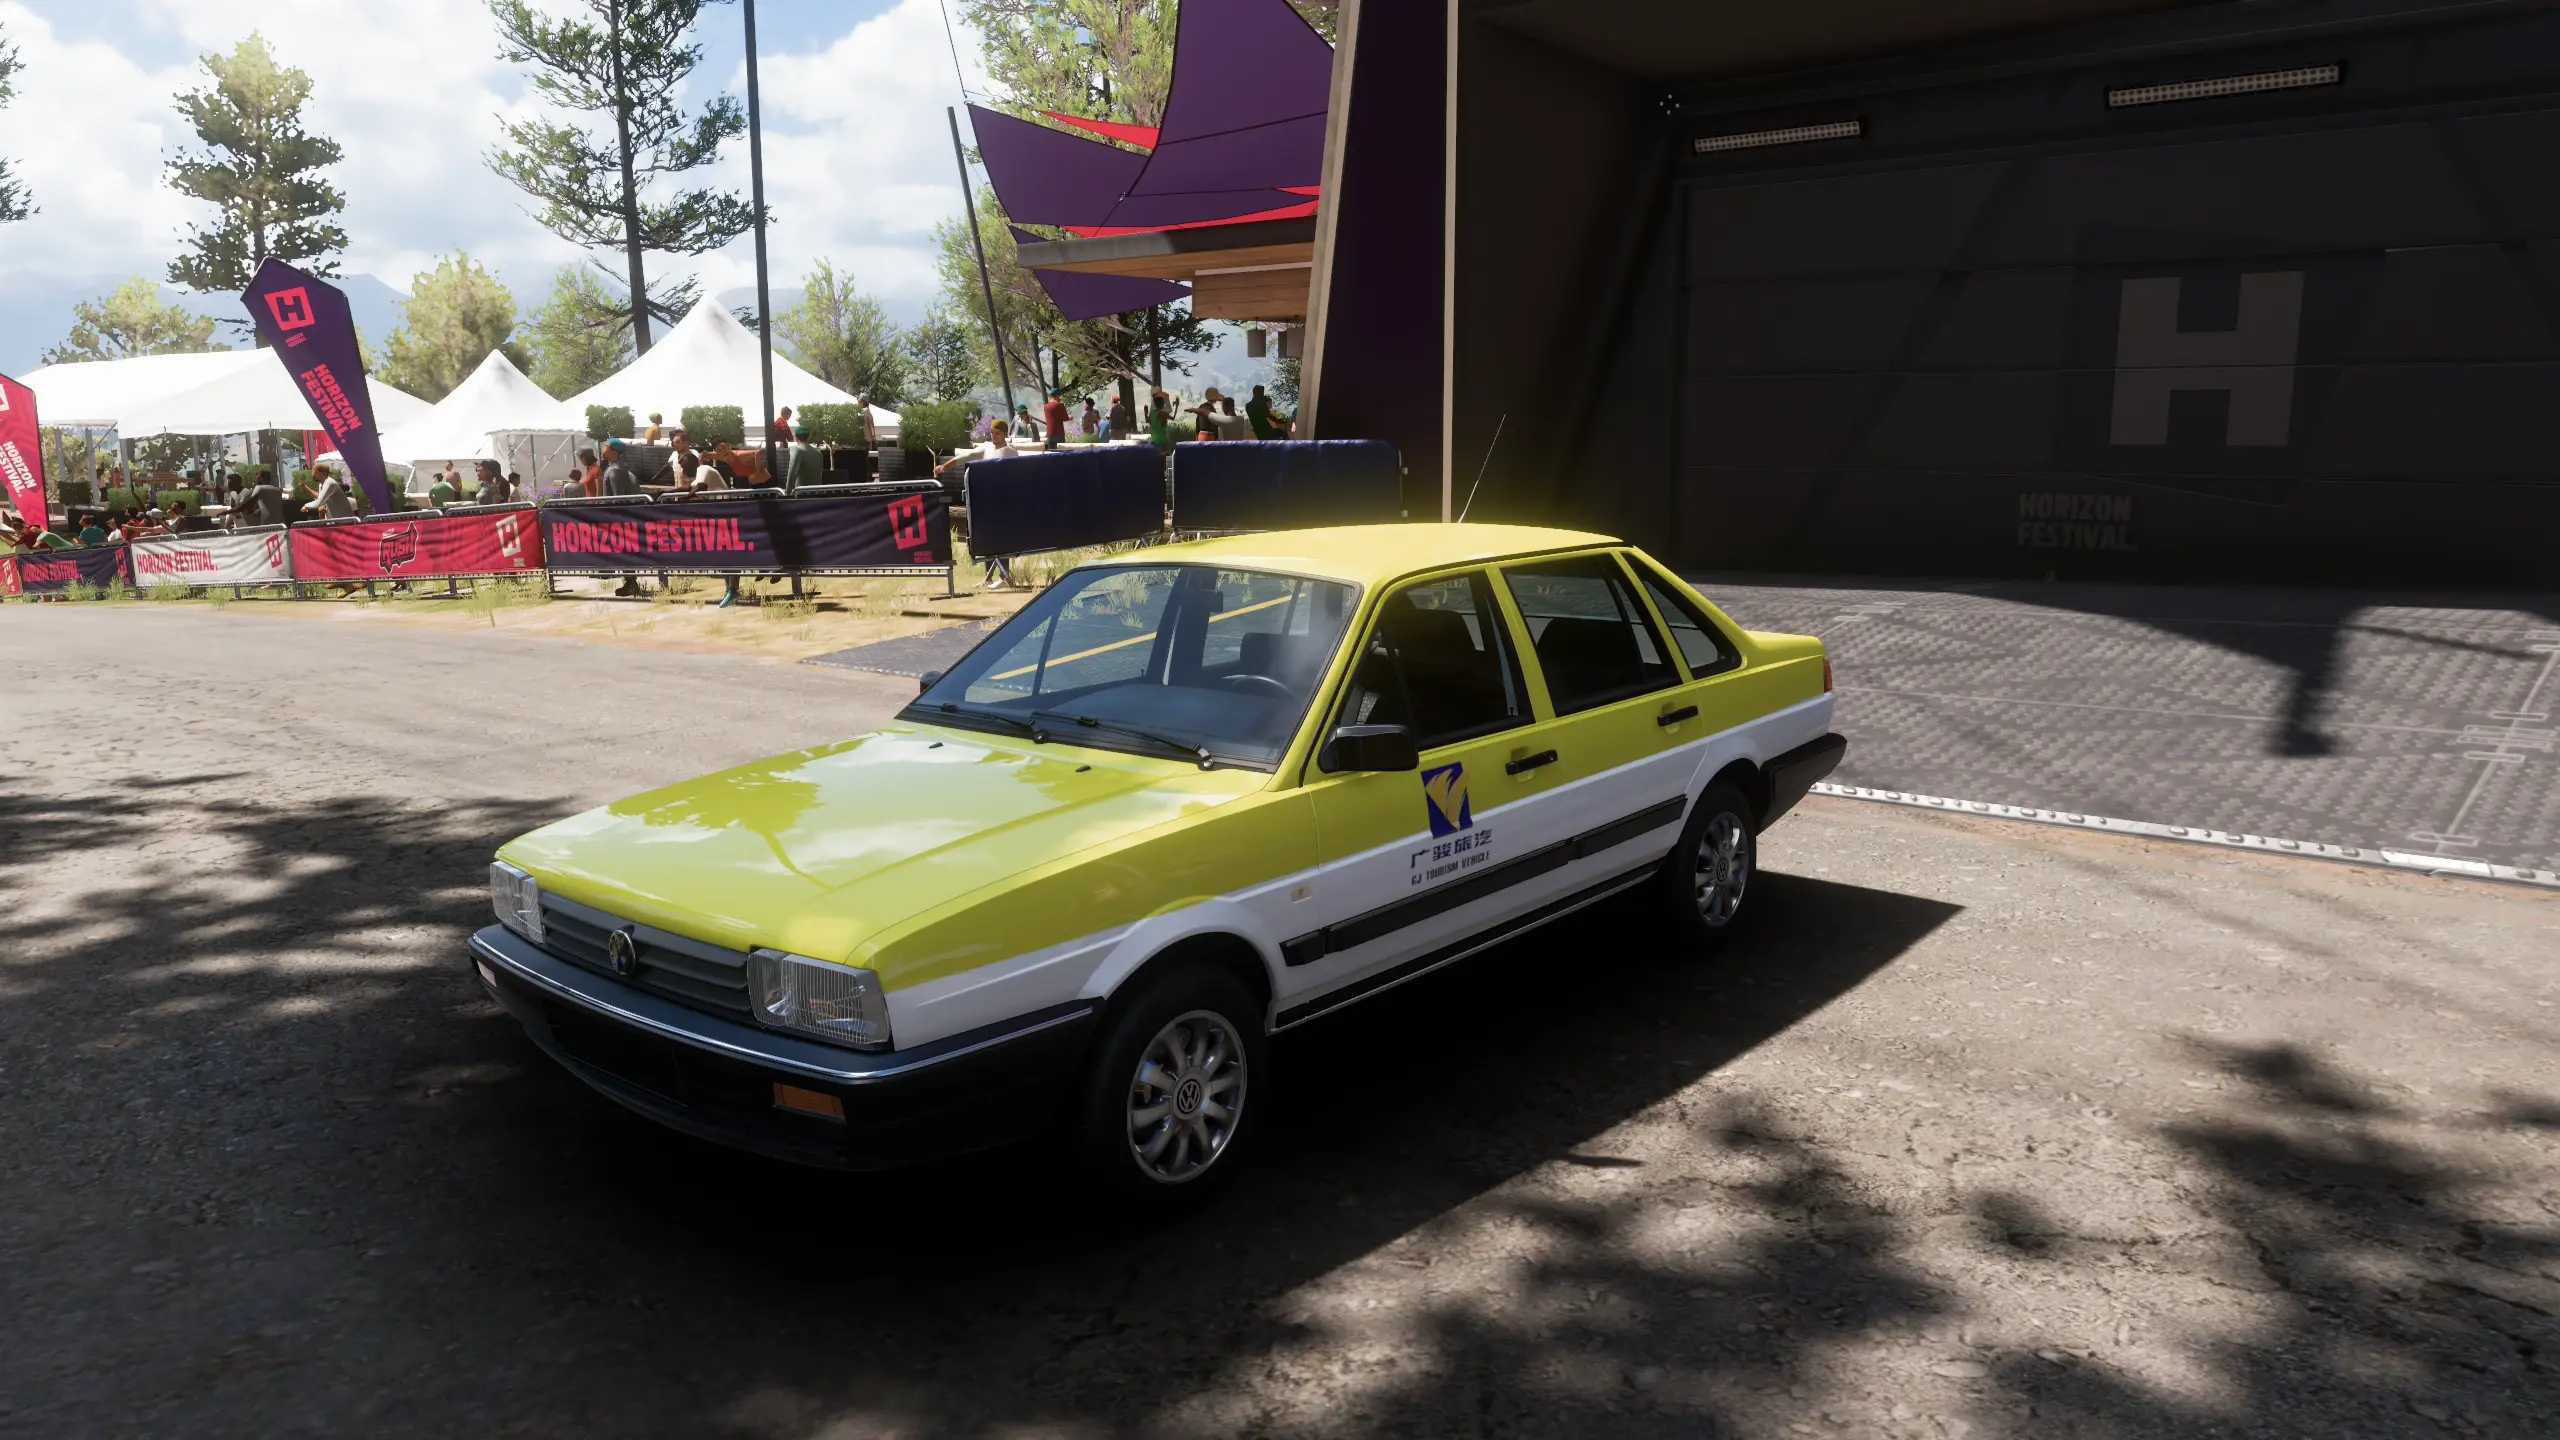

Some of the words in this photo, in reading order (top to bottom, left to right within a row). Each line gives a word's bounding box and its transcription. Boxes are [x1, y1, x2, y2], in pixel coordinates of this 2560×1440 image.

[2110, 270, 2305, 446] H
[300, 369, 349, 443] FESTIVAL.
[313, 363, 364, 431] HORIZON
[3, 440, 37, 489] HORIZON
[2019, 491, 2132, 522] HORIZON
[552, 522, 639, 554] HORIZON
[645, 516, 755, 552] FESTIVAL.
[136, 552, 173, 574] HORIZON
[1426, 860, 1458, 881] TOURISM
[1461, 849, 1491, 869] VEHICLE
